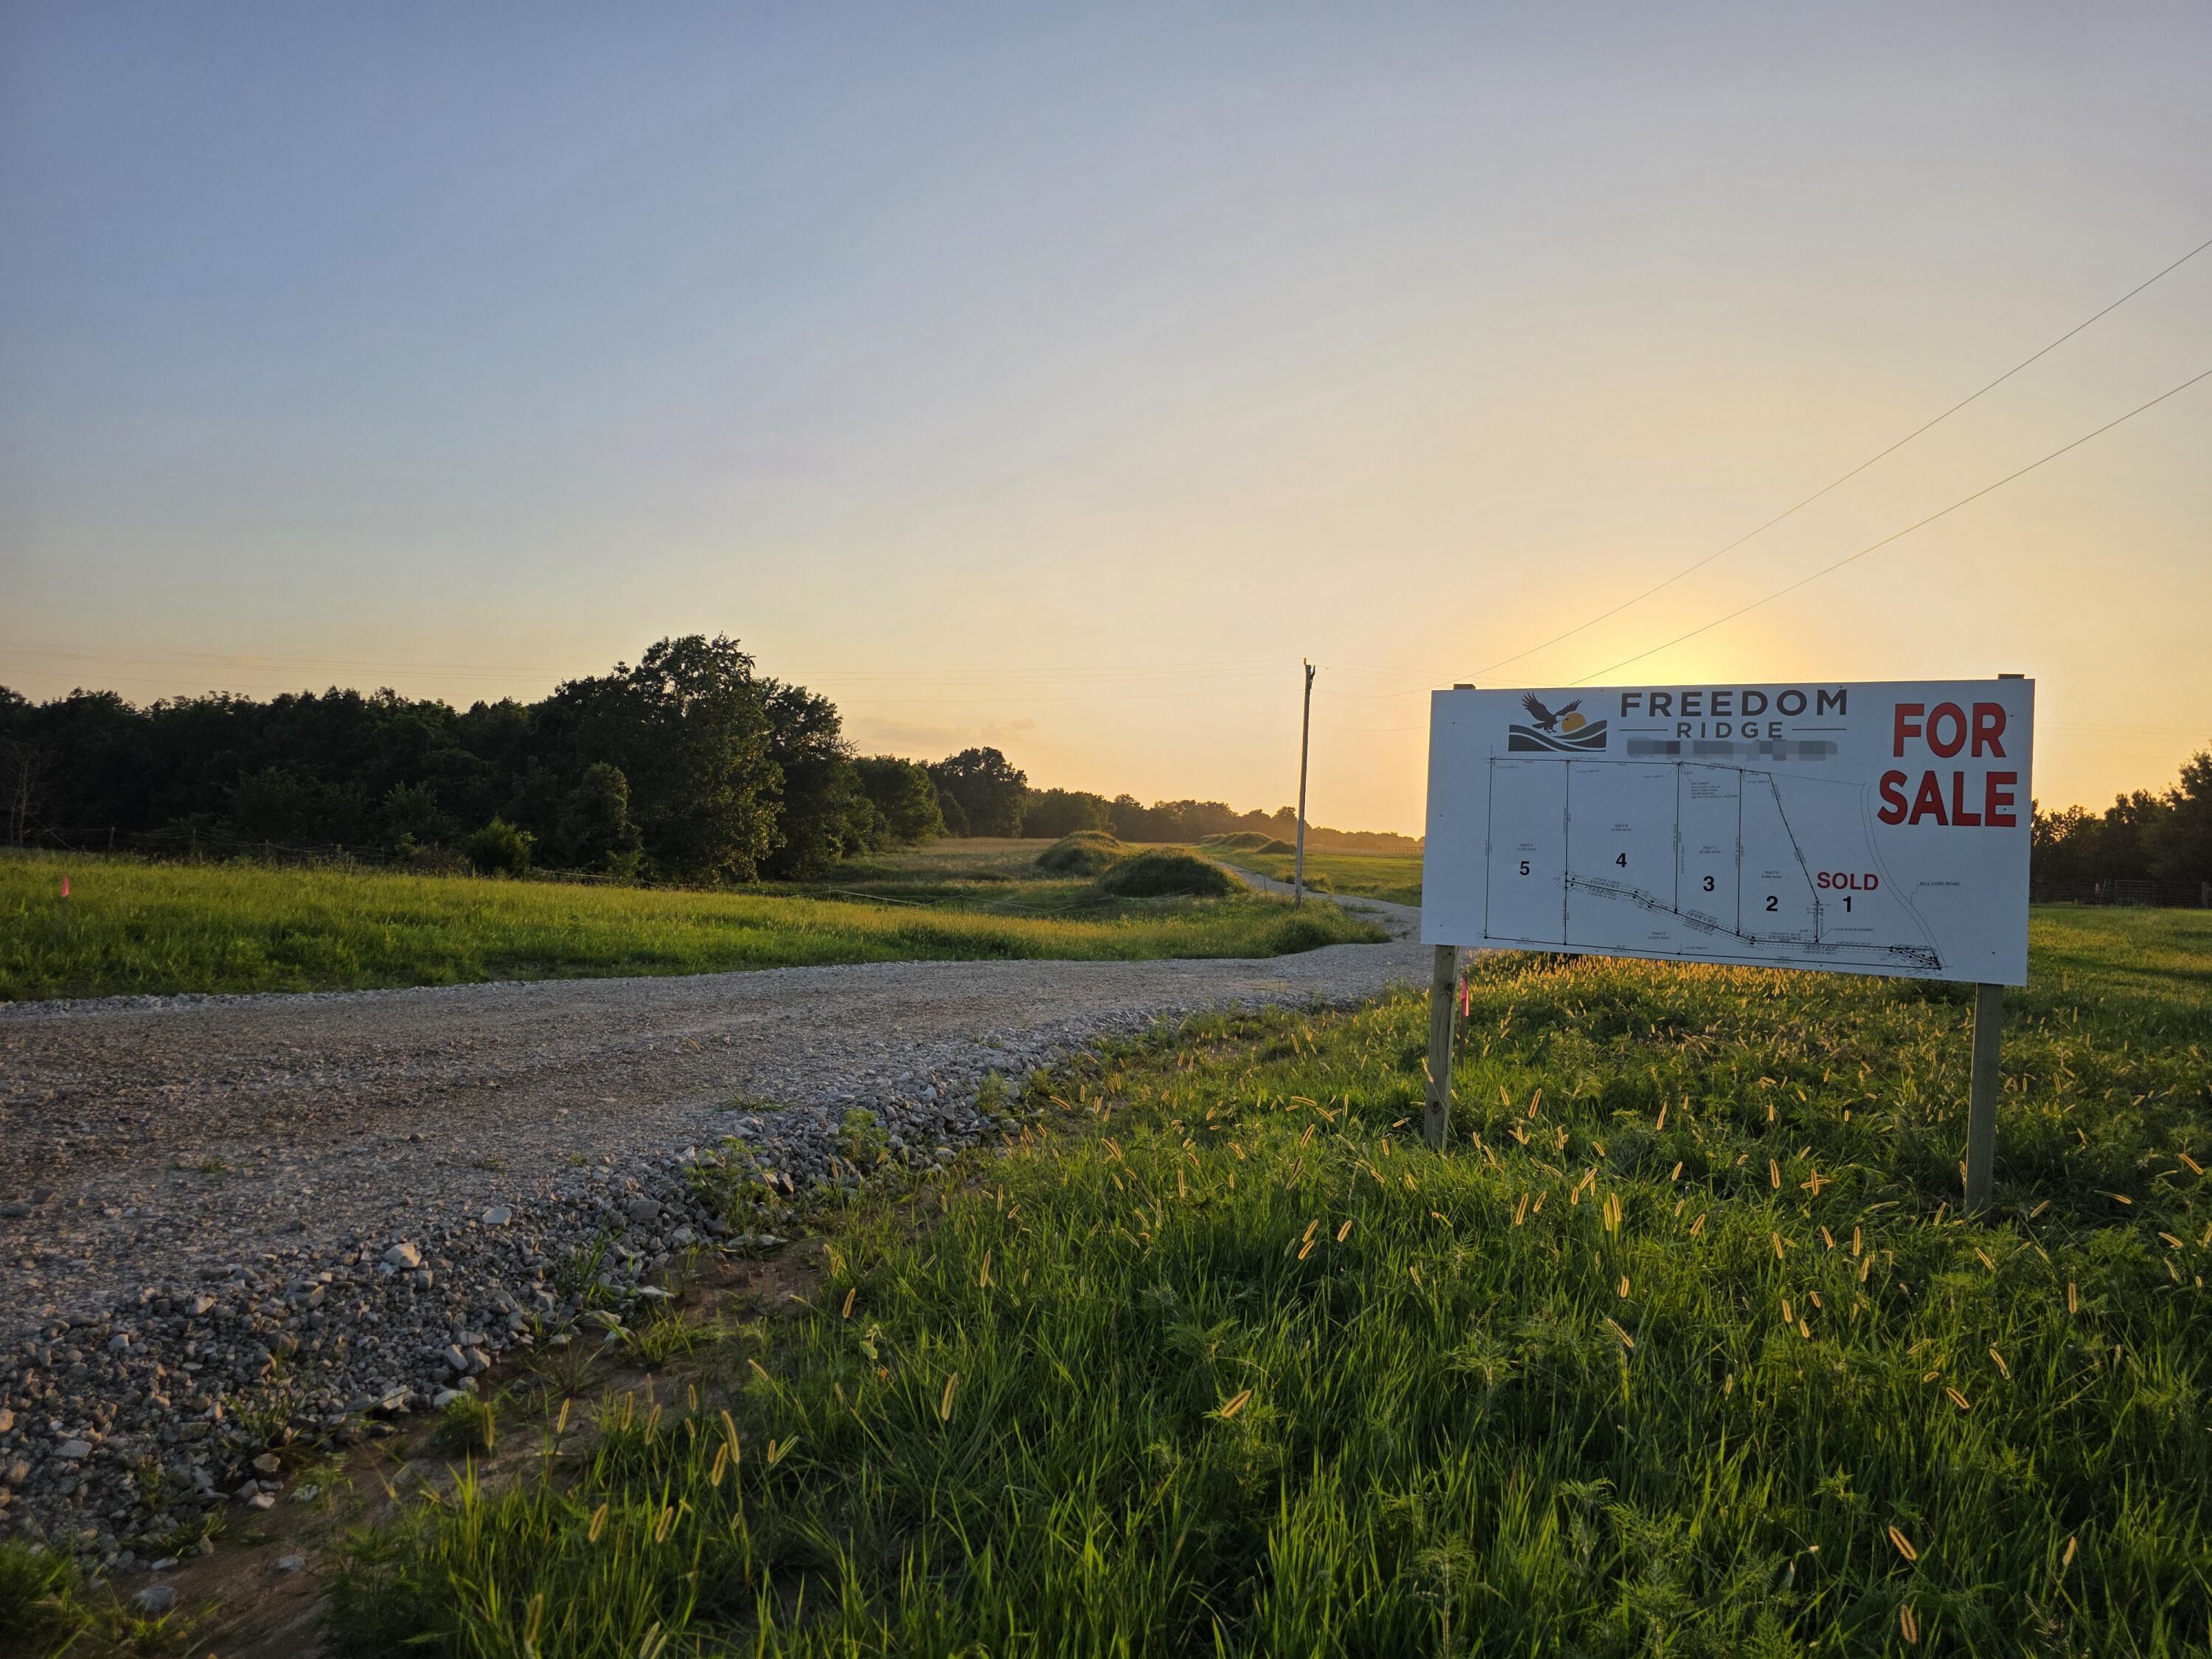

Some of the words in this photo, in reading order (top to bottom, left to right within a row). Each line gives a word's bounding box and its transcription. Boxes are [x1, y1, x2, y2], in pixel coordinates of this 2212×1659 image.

[1621, 689, 1847, 717] FREEDOM
[1677, 721, 1783, 739] RIDGE
[1893, 702, 2006, 758] FOR
[1877, 770, 2017, 827] SALE
[1520, 861, 1530, 875] 5
[1615, 852, 1627, 868] 4
[1703, 876, 1715, 892] 3
[1817, 872, 1879, 891] SOLD
[1765, 896, 1778, 912] 2
[1843, 896, 1851, 912] 1
